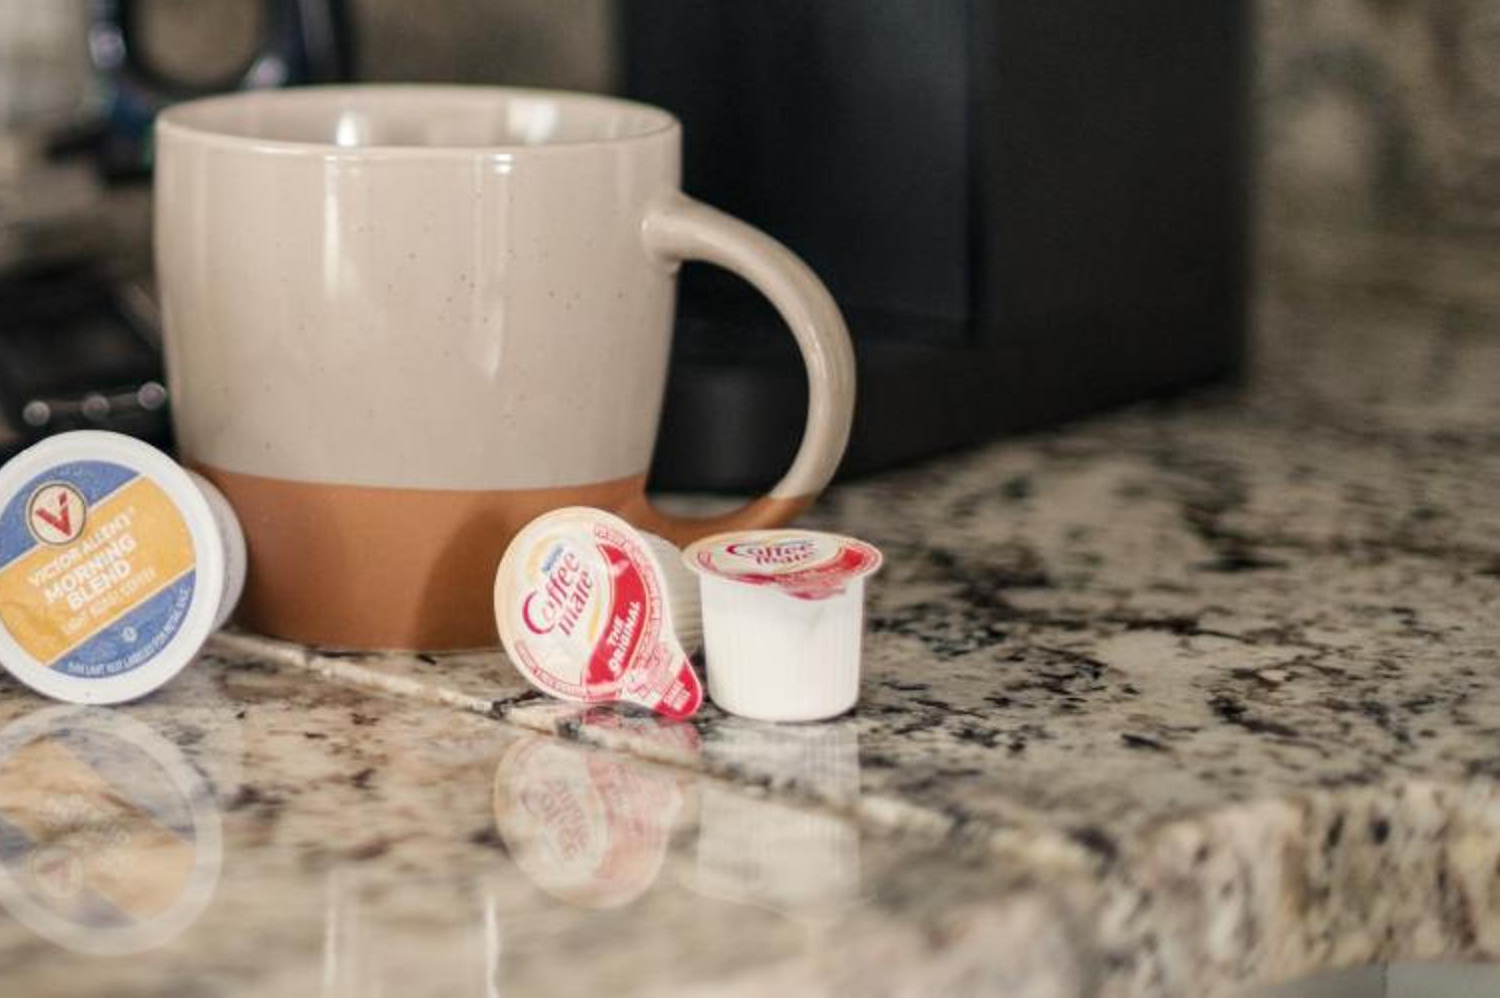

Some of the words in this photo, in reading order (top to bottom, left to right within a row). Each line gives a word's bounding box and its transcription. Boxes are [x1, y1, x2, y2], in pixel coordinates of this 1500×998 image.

[44, 535, 137, 604] MORNING
[726, 542, 817, 558] Coffee
[67, 562, 132, 611] BLEND
[523, 553, 580, 635] Coffee
[558, 572, 594, 636] mate
[607, 615, 626, 646] THE
[608, 601, 642, 672] ORIGINAL
